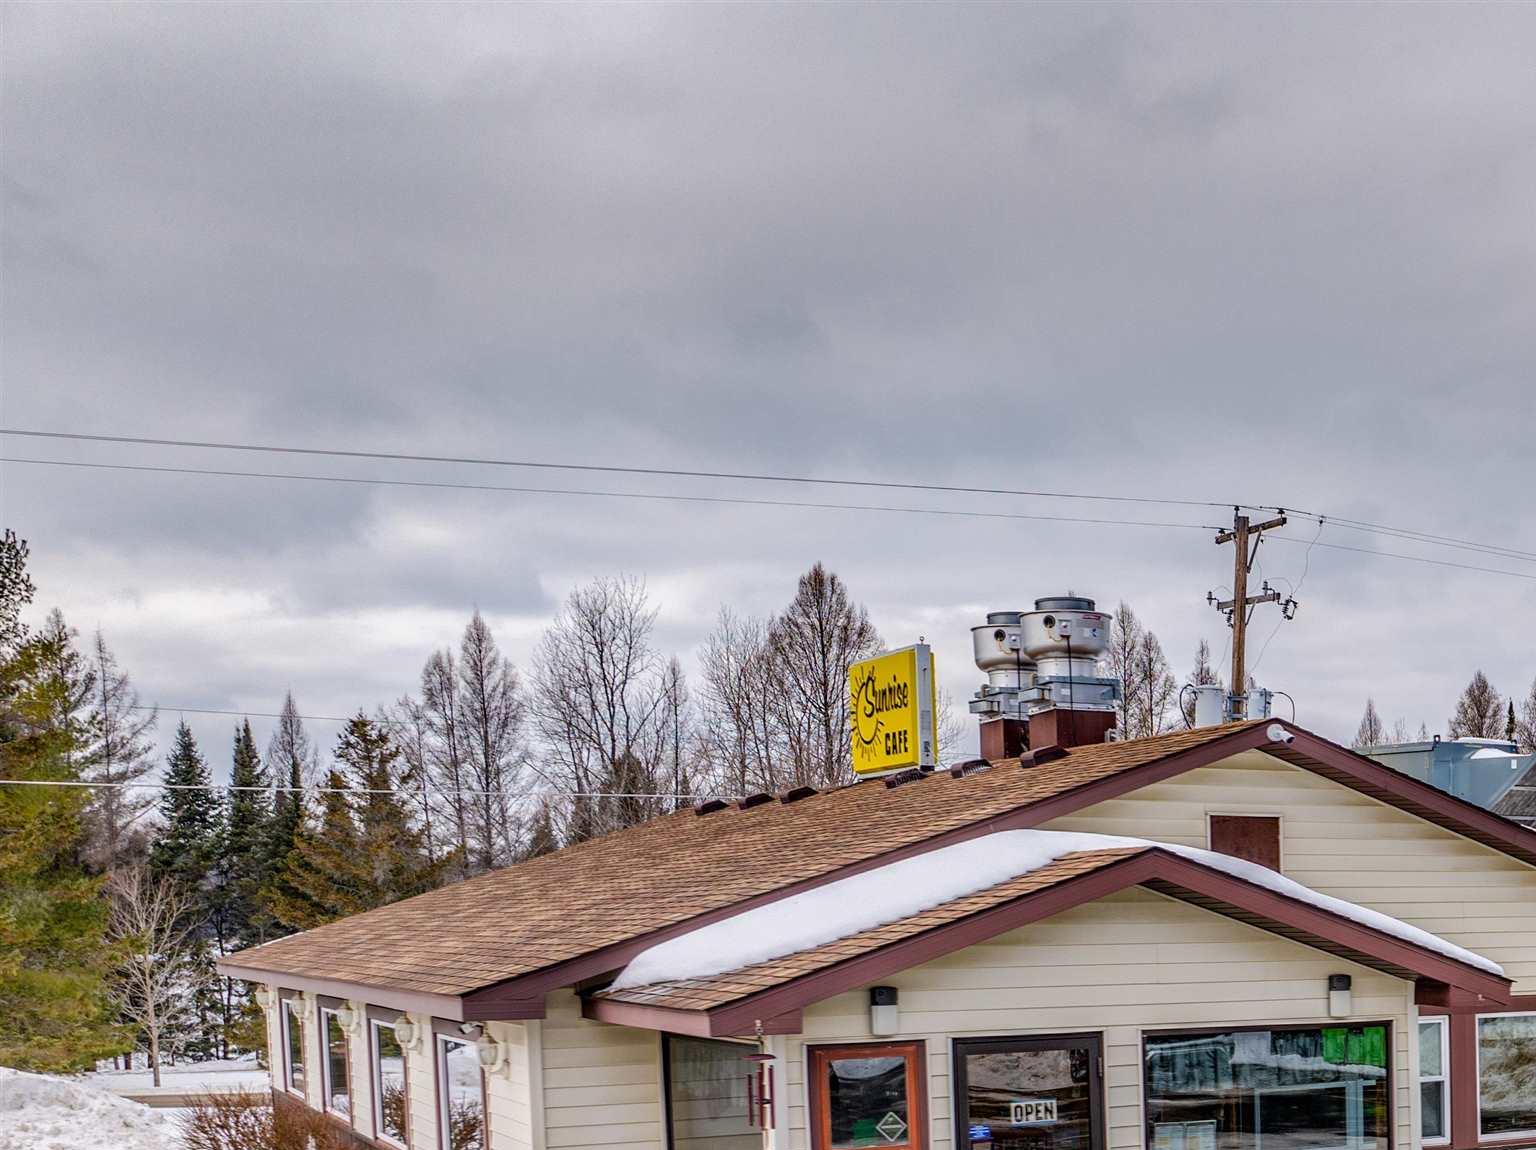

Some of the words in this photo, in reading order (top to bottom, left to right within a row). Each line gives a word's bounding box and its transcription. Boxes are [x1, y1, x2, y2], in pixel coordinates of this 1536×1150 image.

[863, 674, 908, 718] Sunrise
[885, 730, 908, 755] CAFE
[1014, 1101, 1054, 1122] OPEN
